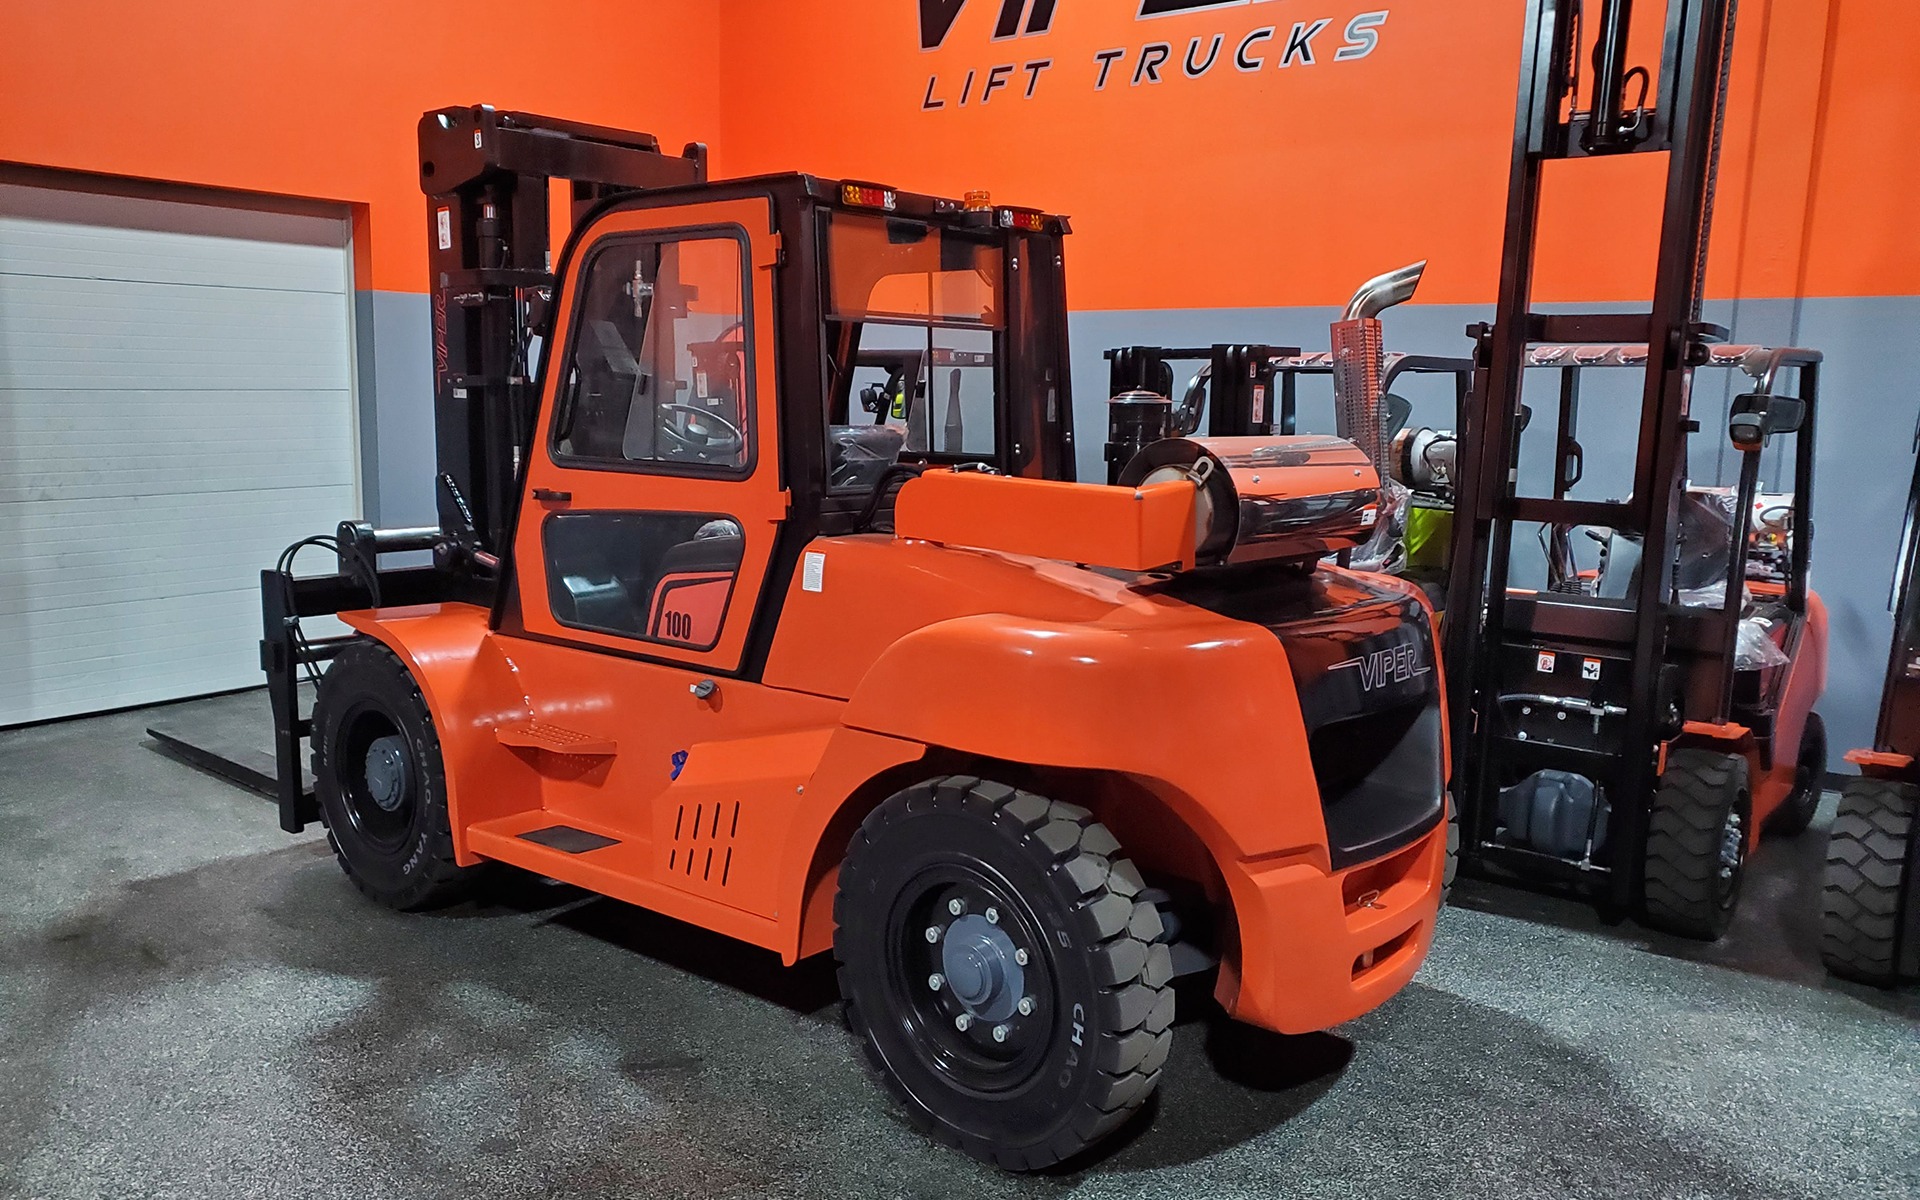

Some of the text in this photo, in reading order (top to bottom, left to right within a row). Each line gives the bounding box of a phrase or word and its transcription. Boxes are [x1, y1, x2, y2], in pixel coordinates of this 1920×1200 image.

[921, 58, 1054, 112] LIFT
[1094, 10, 1389, 91] TRUCKS
[664, 610, 692, 640] 100
[1327, 642, 1431, 692] VIPER
[402, 738, 432, 875] CHAO YANG
[1058, 1002, 1085, 1089] CHAO
